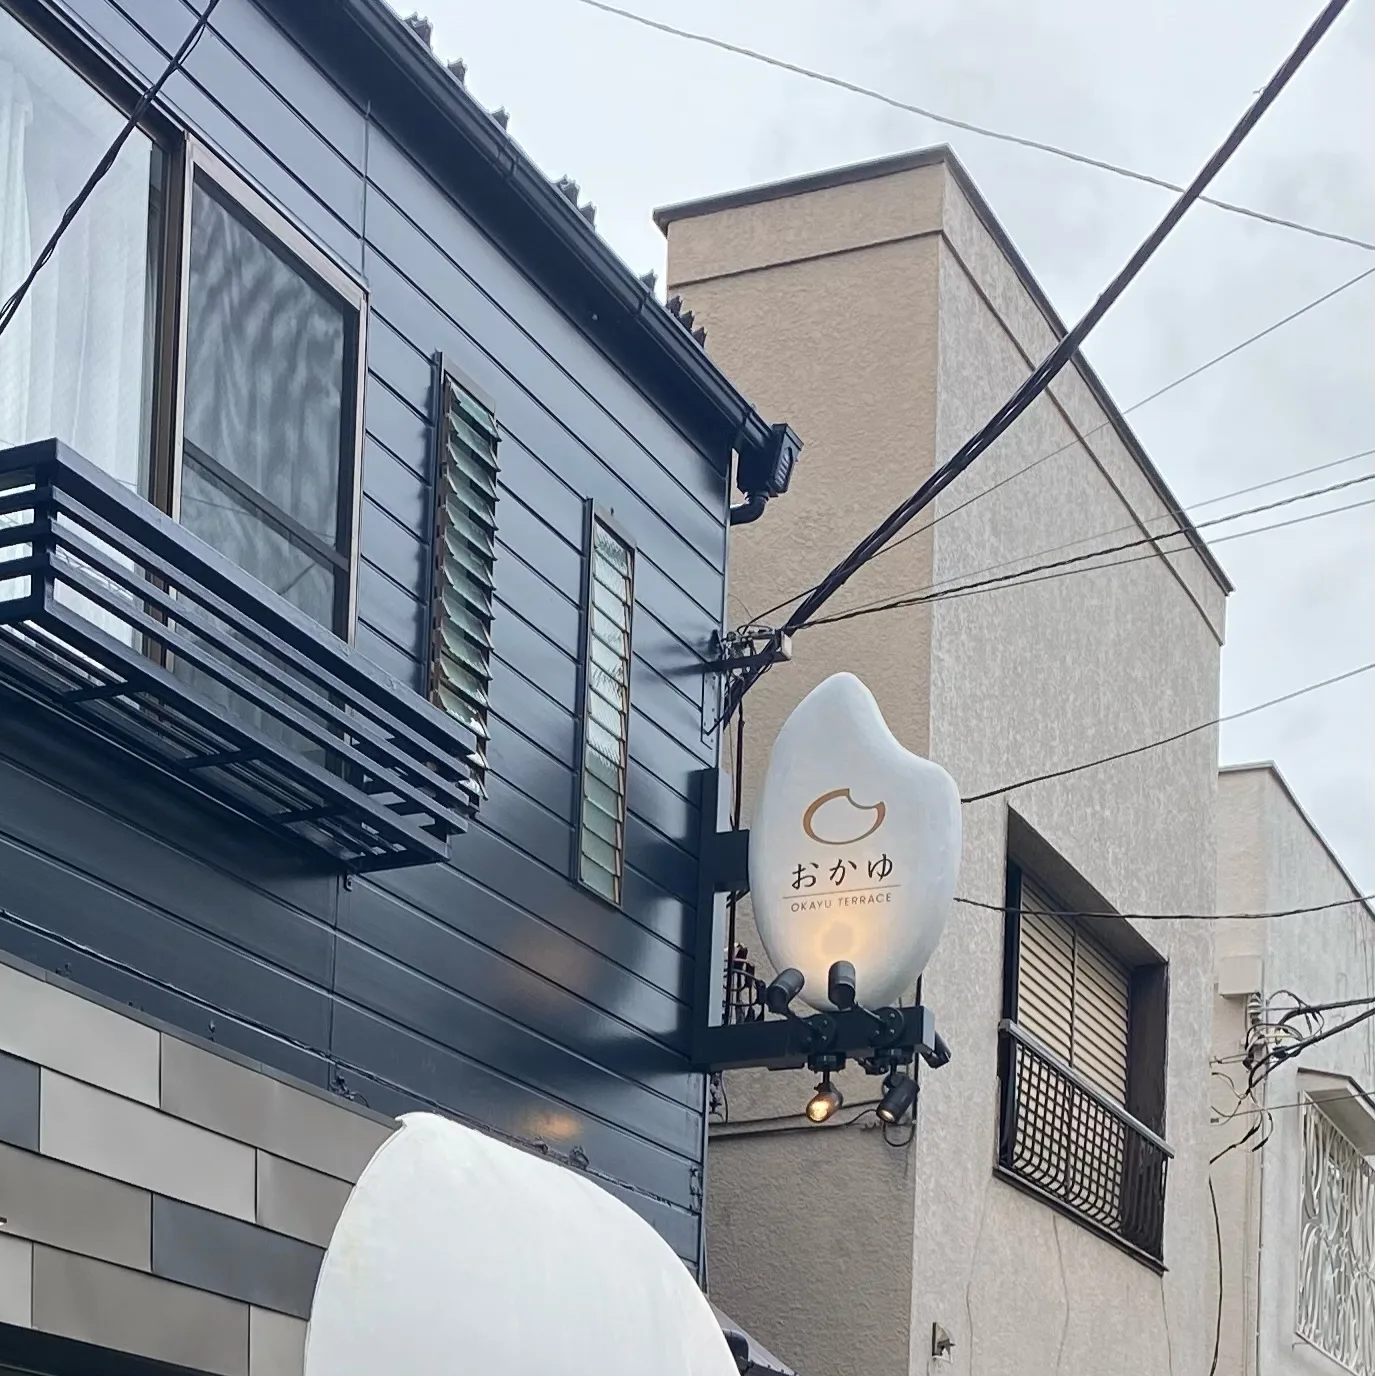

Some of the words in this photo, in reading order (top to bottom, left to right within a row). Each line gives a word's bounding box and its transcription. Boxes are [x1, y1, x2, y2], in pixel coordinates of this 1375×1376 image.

[791, 853, 893, 890] おかゆ
[791, 900, 832, 912] OKAYU
[838, 893, 892, 908] TERRACE
